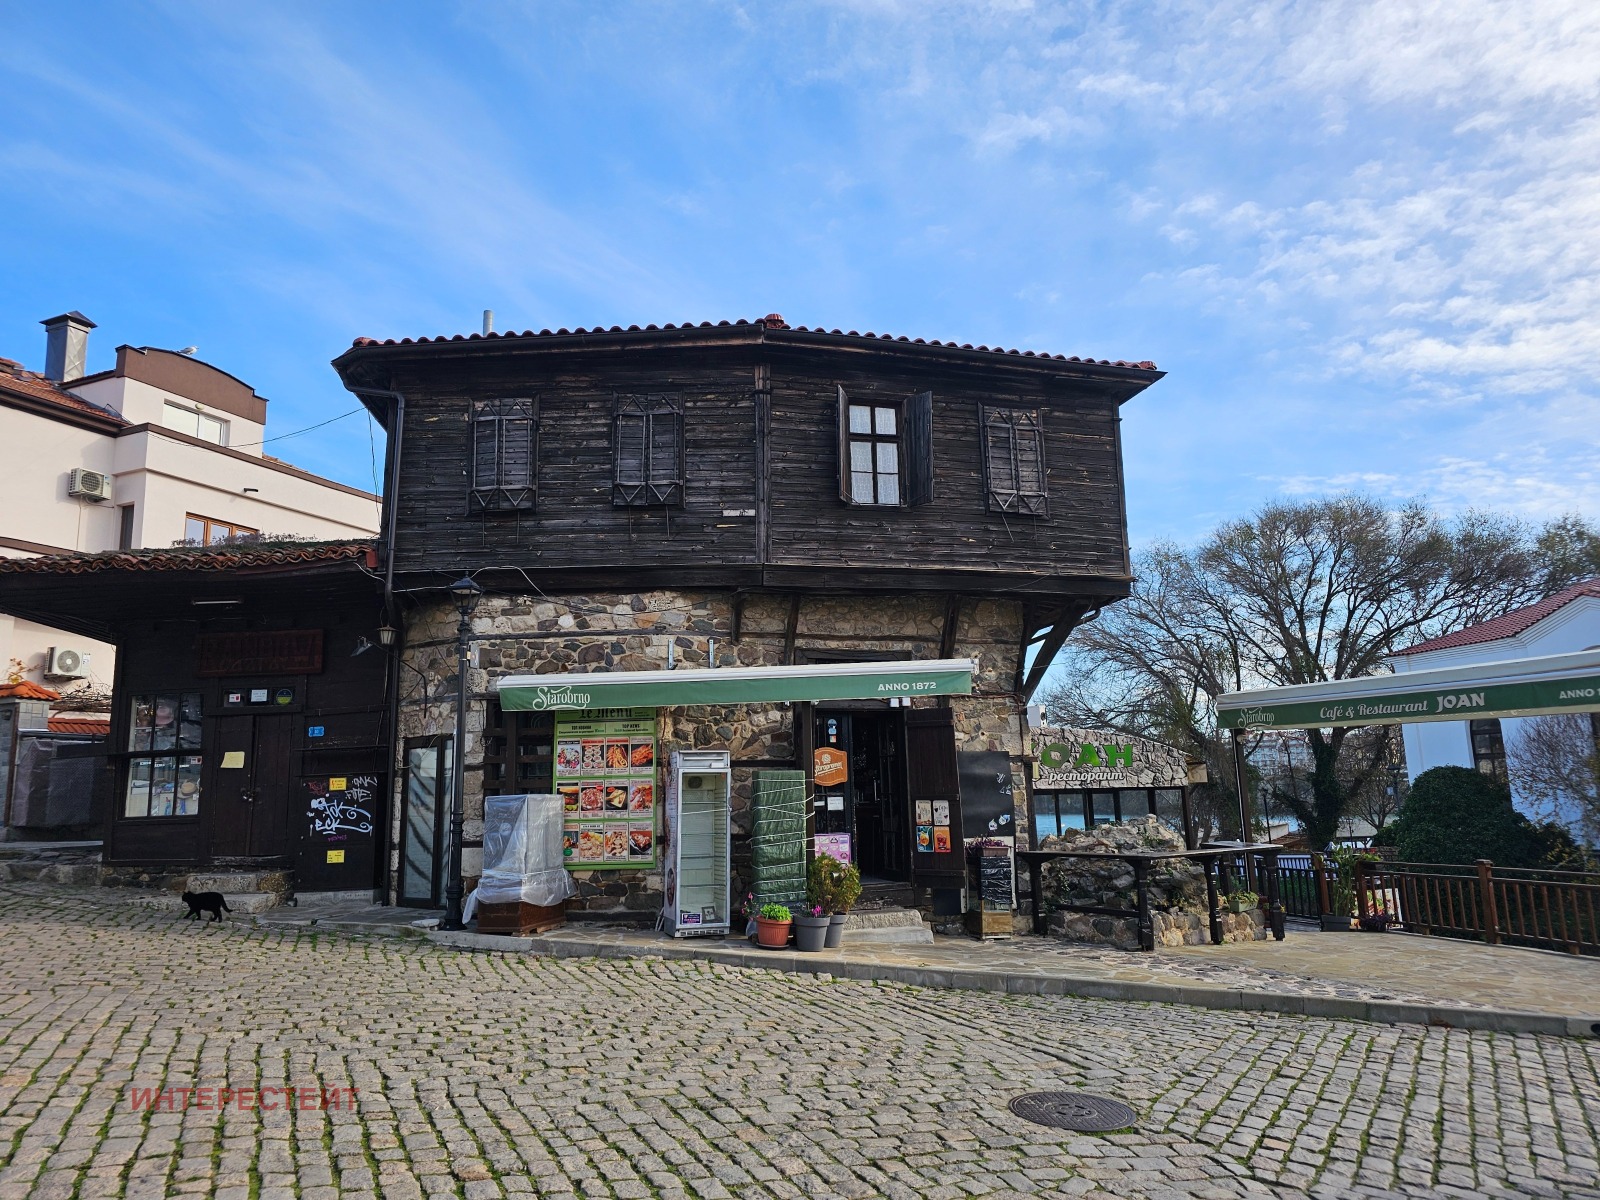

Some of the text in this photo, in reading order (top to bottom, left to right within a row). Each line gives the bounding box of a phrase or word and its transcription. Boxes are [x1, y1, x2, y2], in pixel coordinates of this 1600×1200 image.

[532, 686, 591, 710] Starobrno
[878, 681, 937, 691] ANNO 1872
[1559, 688, 1595, 699] ANNO
[1237, 705, 1275, 729] Starobrno
[1319, 692, 1485, 721] Café & Restaurant JOAN
[1031, 742, 1133, 768] ОАН
[1049, 772, 1124, 785] ресторант
